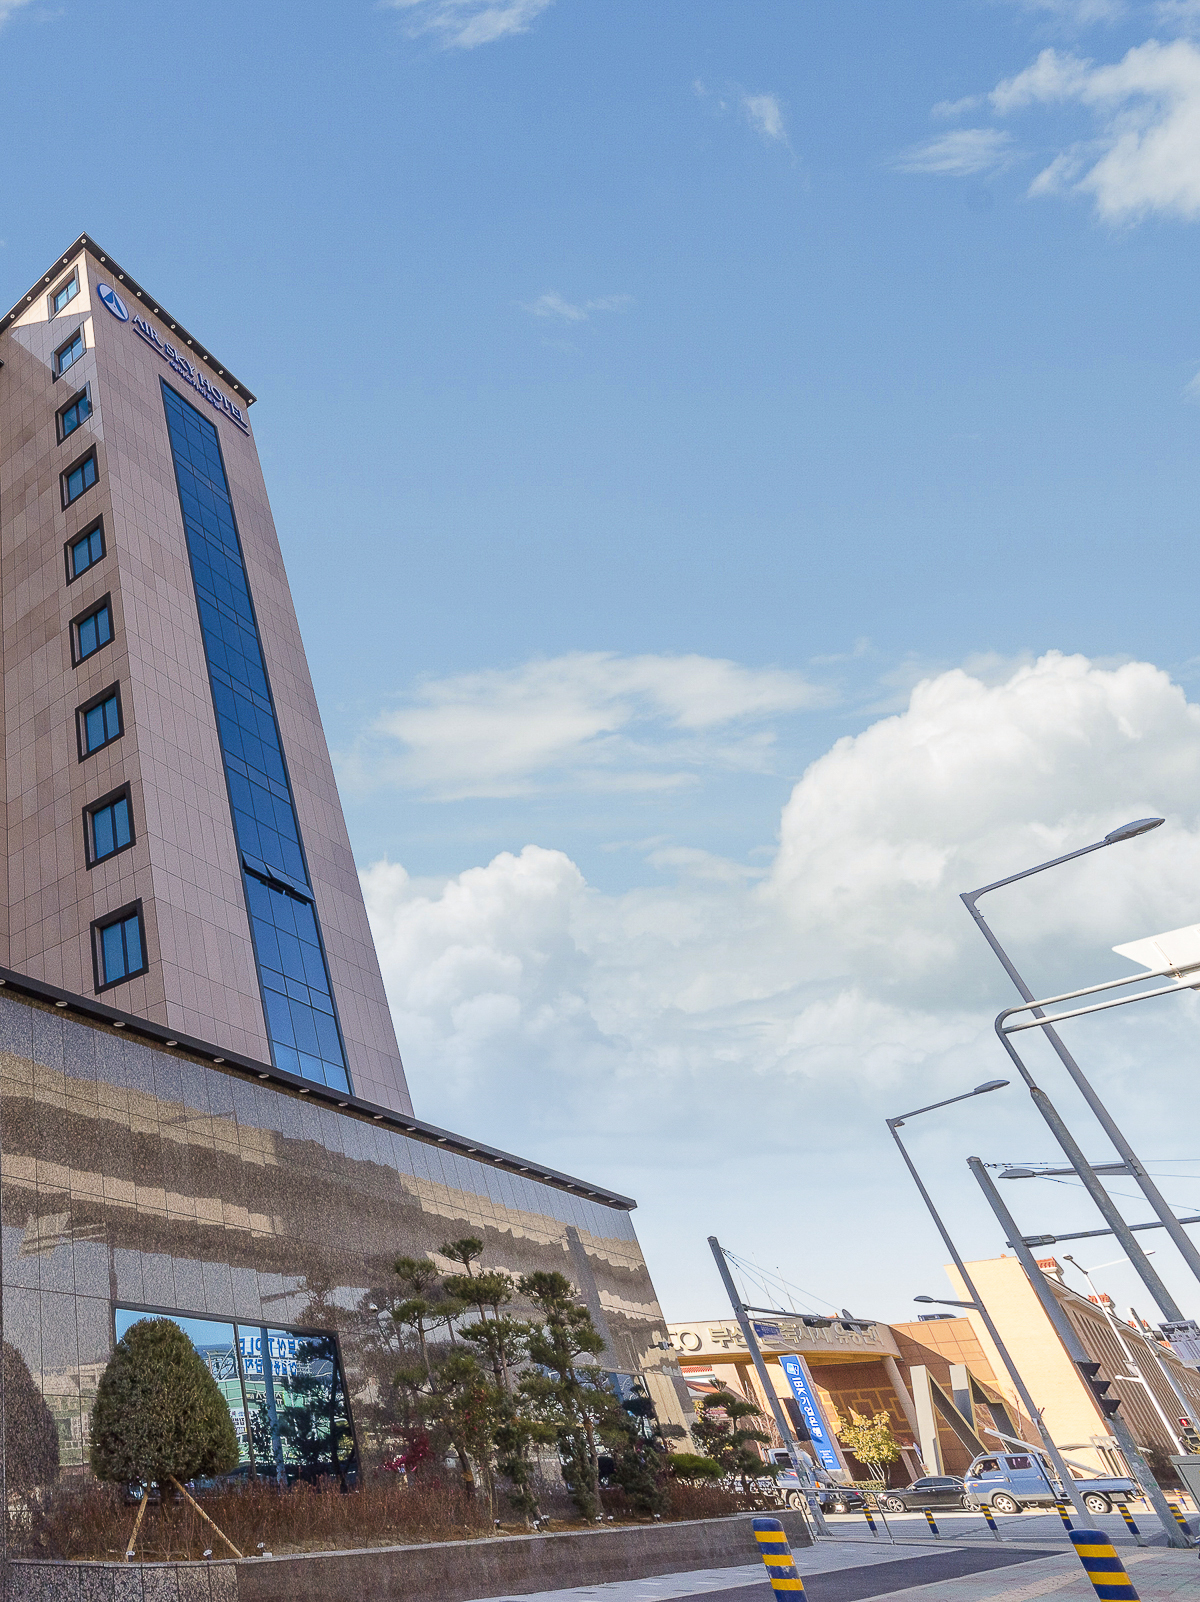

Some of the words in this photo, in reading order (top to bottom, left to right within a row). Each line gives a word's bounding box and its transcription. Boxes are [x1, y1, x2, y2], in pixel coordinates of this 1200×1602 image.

[132, 314, 163, 349] AIR
[164, 342, 196, 377] SKY
[197, 372, 248, 428] HOTEL
